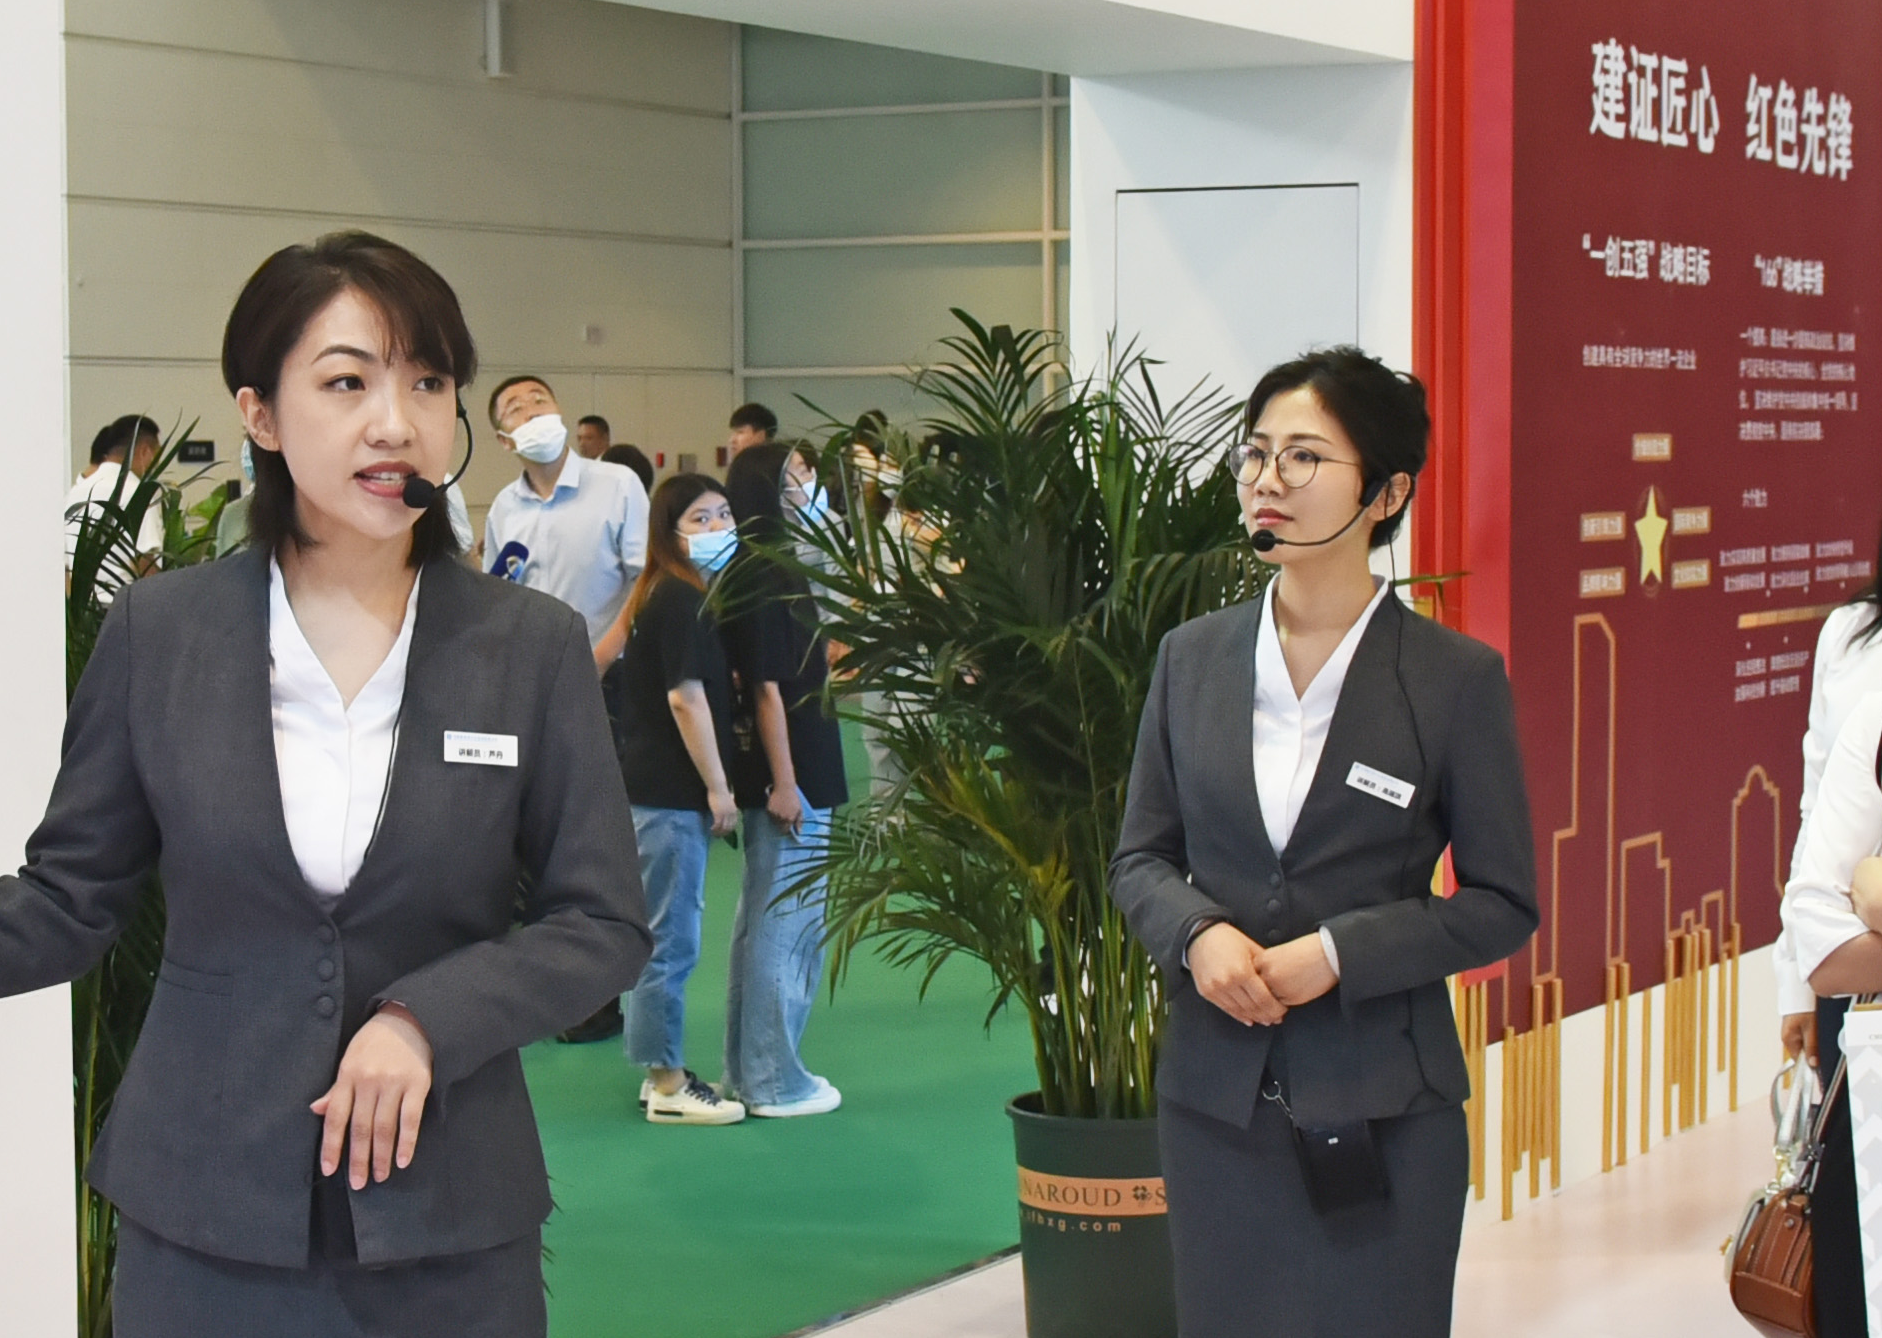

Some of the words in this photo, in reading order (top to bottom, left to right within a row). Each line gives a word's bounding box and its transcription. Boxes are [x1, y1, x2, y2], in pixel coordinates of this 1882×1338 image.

[1590, 38, 1720, 154] 建证匠心
[1745, 73, 1853, 181] 红色先锋
